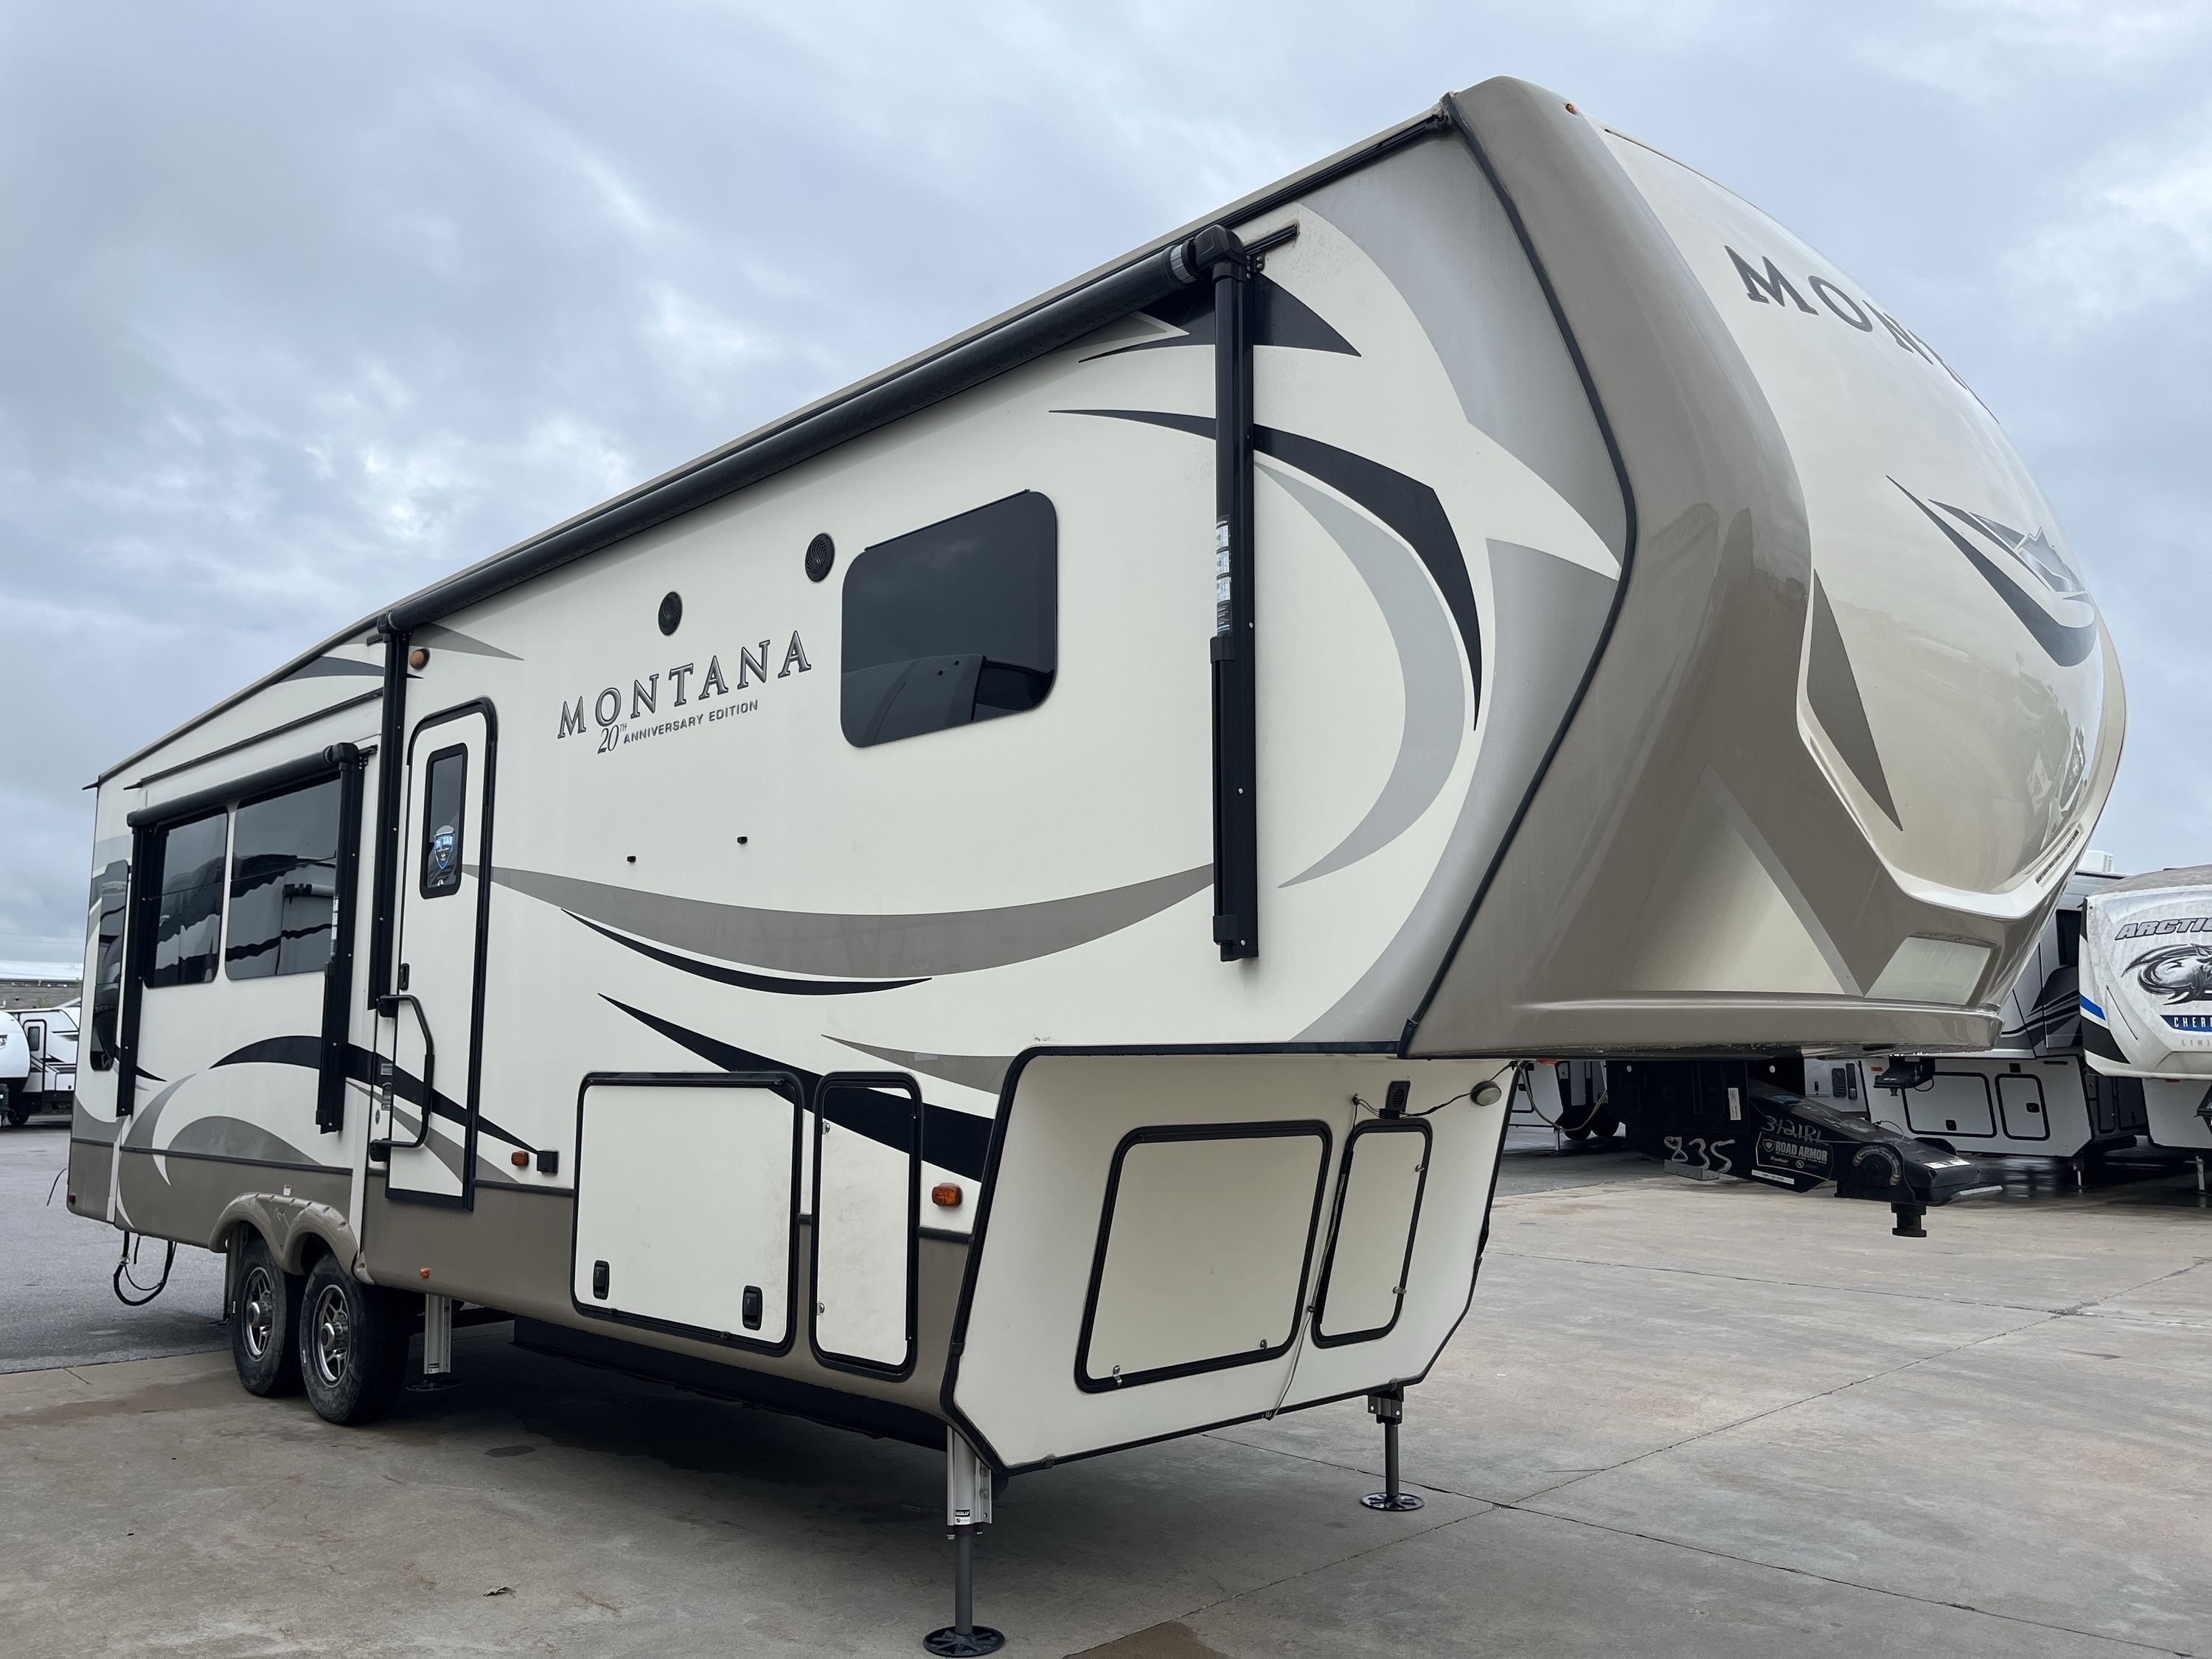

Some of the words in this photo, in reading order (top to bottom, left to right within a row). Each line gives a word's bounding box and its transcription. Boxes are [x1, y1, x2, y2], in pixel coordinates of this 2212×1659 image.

[557, 630, 812, 740] MONTANA
[623, 713, 704, 745] ANNIVERSARY
[709, 699, 759, 722] EDITION
[1663, 1135, 1735, 1174] 835
[1775, 1141, 1798, 1155] ROAD
[1798, 1146, 1829, 1162] ARMOR
